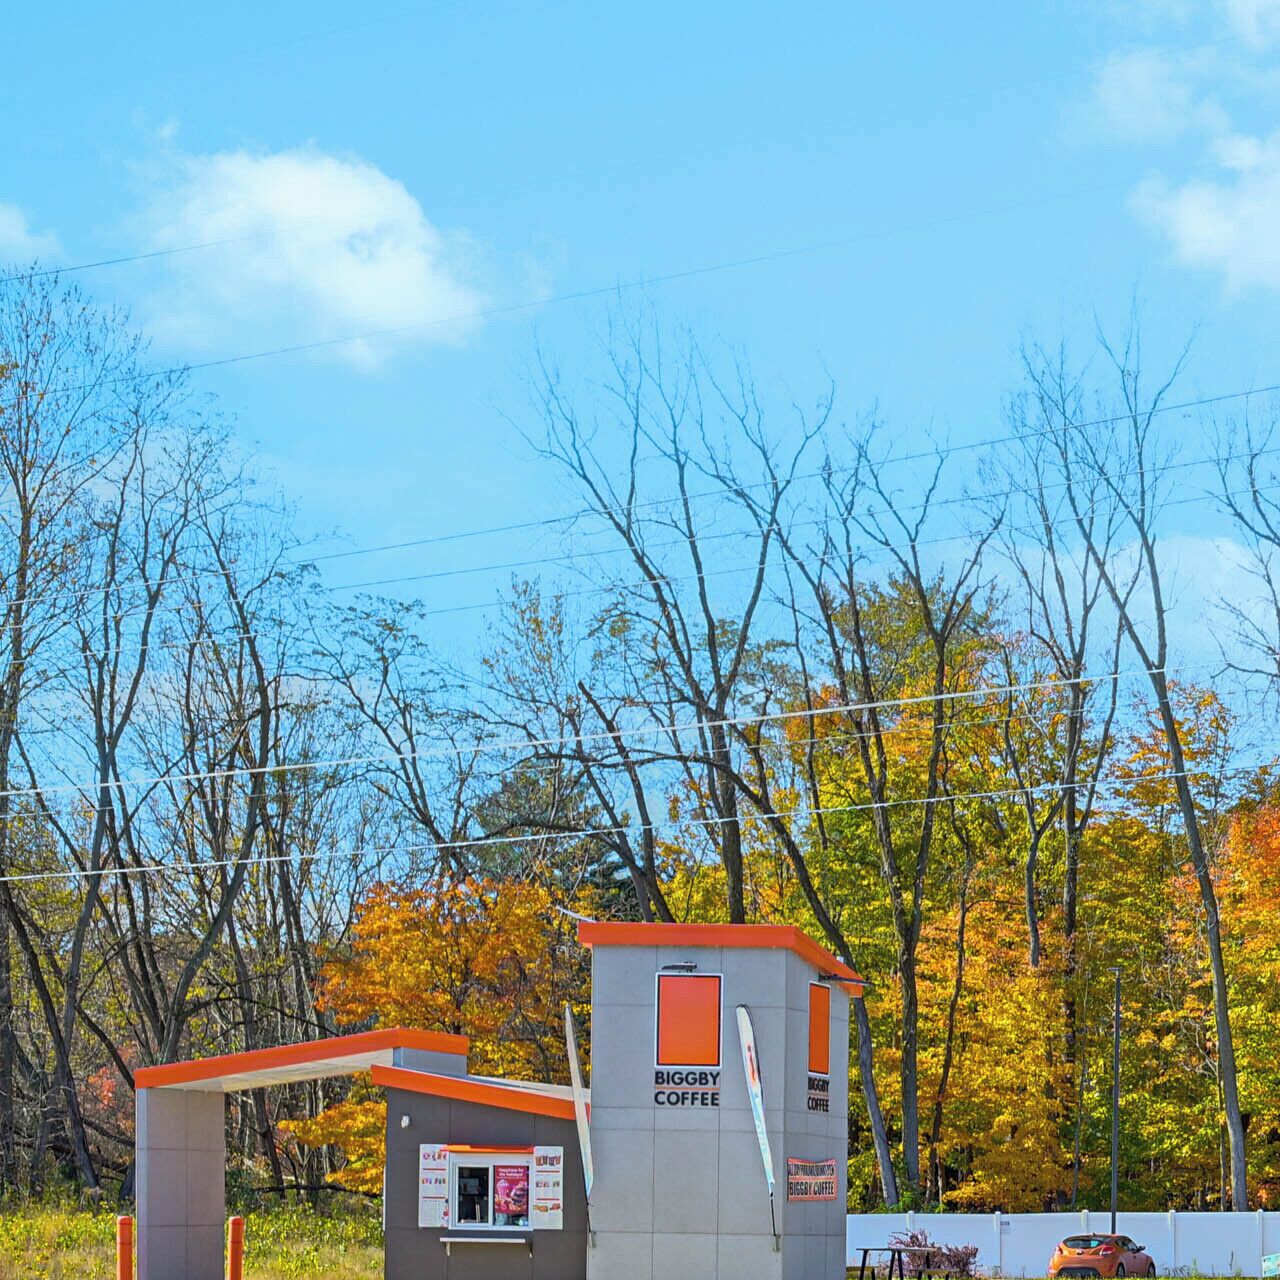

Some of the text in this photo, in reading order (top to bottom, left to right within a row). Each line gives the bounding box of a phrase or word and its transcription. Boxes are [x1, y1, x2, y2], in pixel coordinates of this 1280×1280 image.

[655, 1071, 720, 1086] BIGGBY
[808, 1077, 829, 1093] BIGGBY
[654, 1091, 720, 1106] COFFEE
[807, 1097, 829, 1112] COFFEE
[813, 1181, 834, 1196] COFFEE
